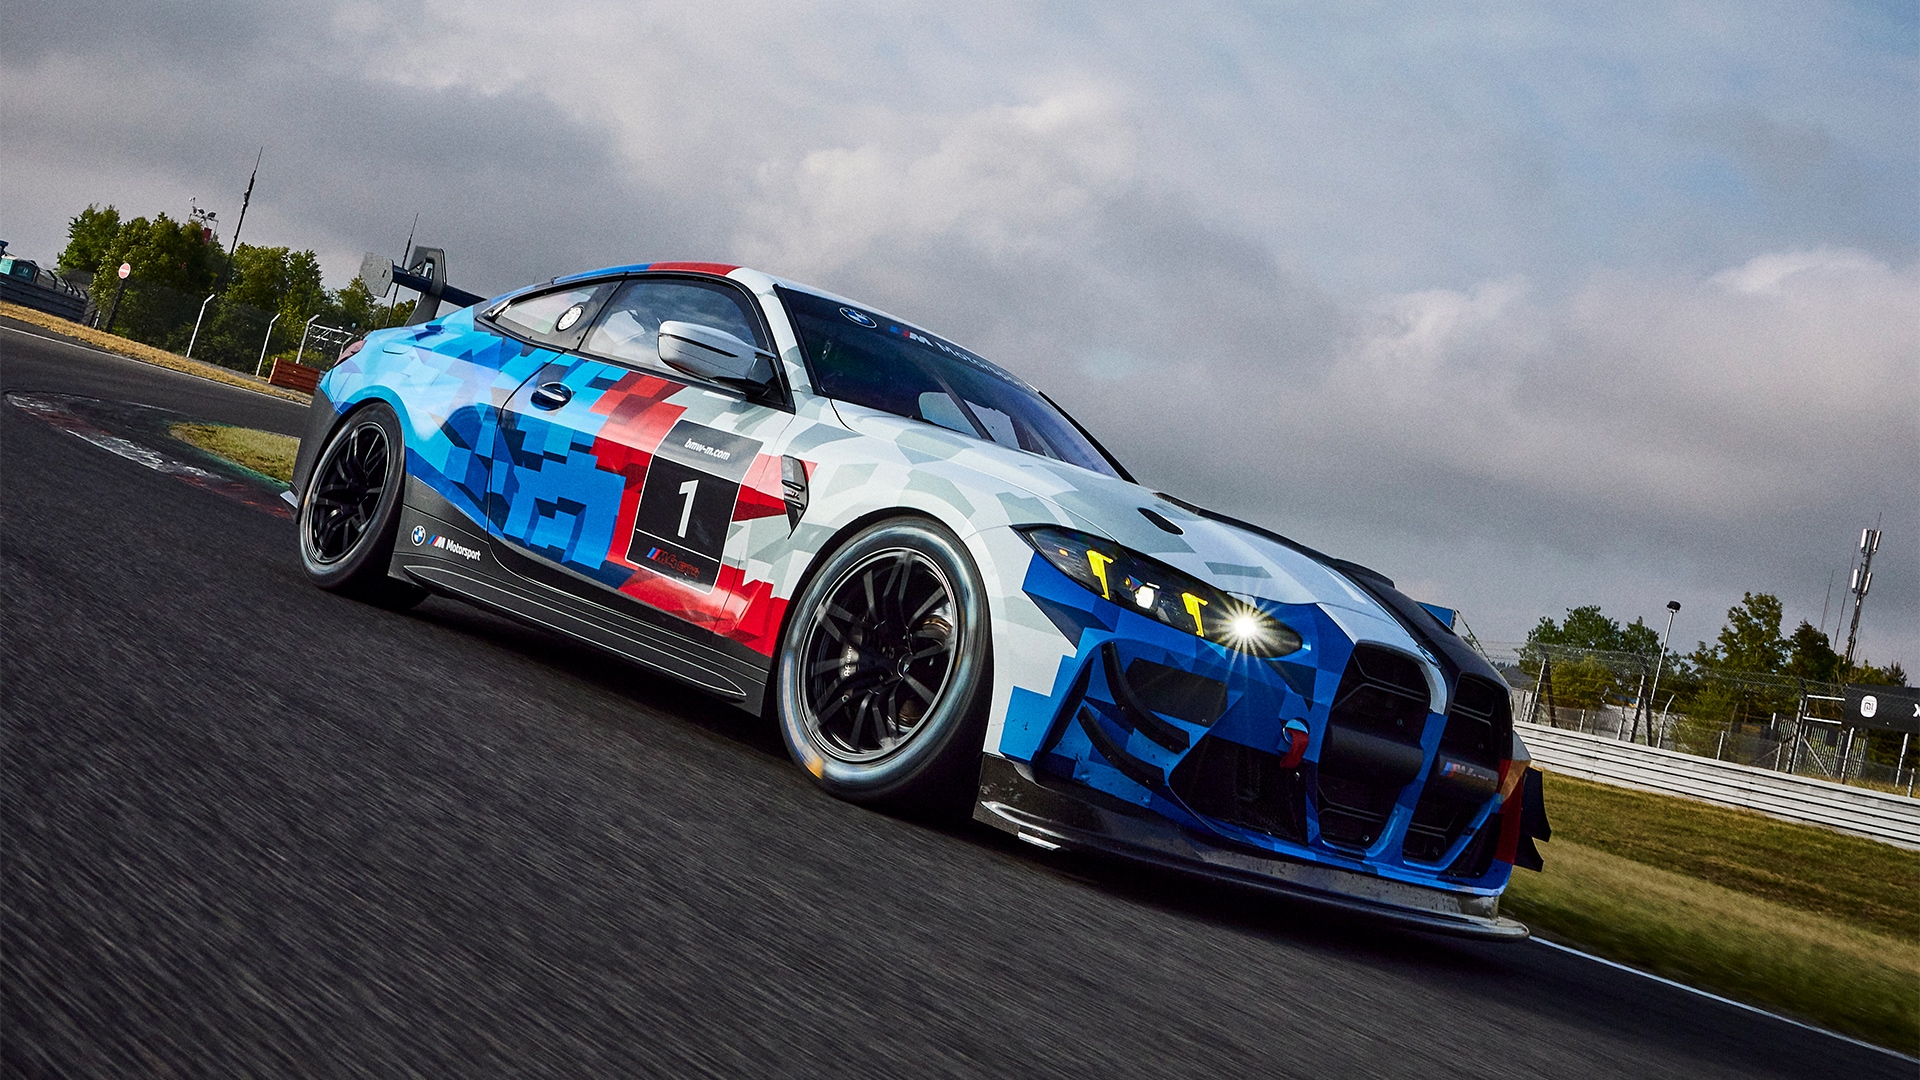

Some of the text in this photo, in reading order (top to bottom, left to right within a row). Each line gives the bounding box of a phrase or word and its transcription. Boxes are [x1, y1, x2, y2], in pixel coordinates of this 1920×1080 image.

[684, 437, 731, 461] bmw-m.com
[678, 479, 699, 539] 1
[445, 538, 481, 561] Motorsport
